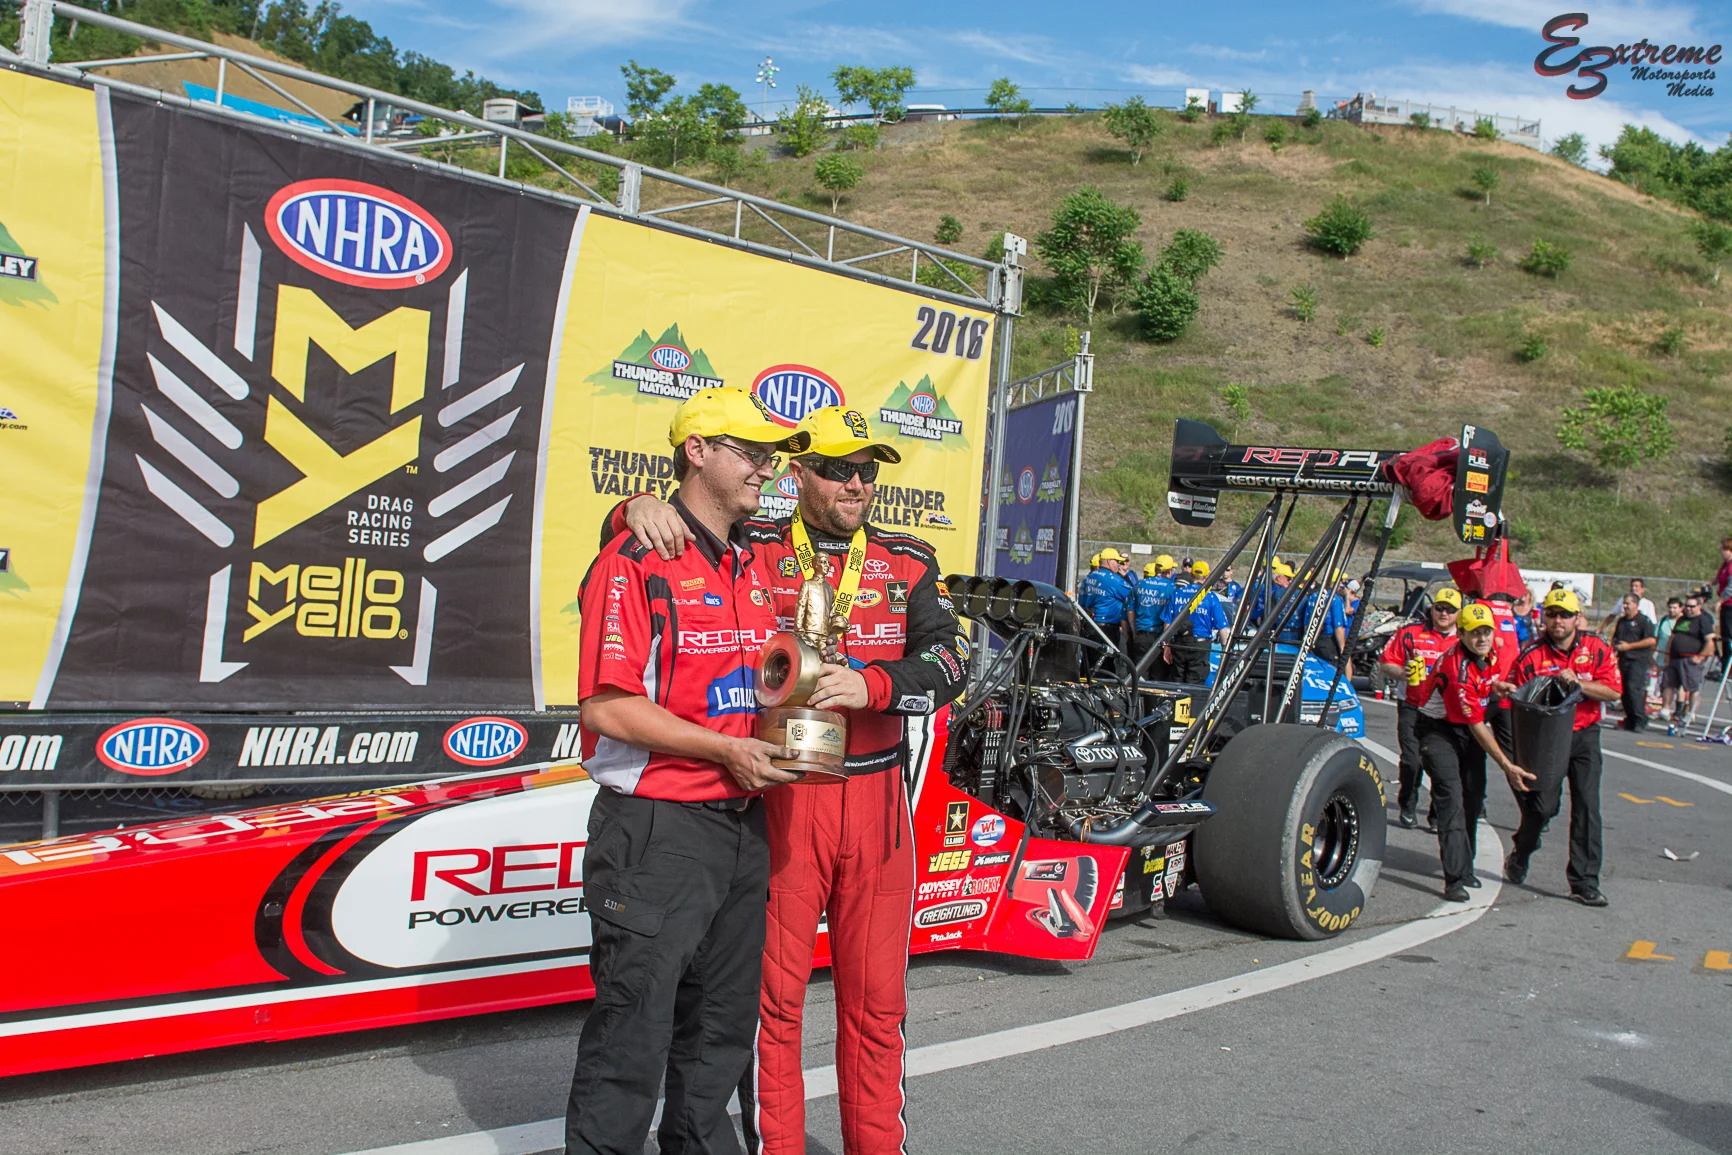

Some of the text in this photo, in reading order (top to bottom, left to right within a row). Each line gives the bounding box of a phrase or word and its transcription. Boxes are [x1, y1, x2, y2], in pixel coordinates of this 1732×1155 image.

[297, 197, 427, 271] NHRA
[911, 306, 989, 360] 2016
[656, 348, 686, 369] NHRA
[614, 362, 674, 386] THUNDER
[766, 375, 832, 419] NHRA
[913, 397, 935, 414] NHRA
[880, 409, 962, 434] THUNDER VALLEY
[900, 424, 942, 440] NATIONALS
[589, 446, 677, 480] THUND
[591, 472, 673, 501] VALLEY
[367, 495, 413, 513] DRAG
[347, 510, 412, 530] RACING
[348, 529, 410, 548] SERIES
[248, 557, 405, 602] Mello
[862, 572, 894, 581] TOYOTA
[854, 592, 878, 602] PENNZOIL
[678, 645, 730, 655] POWERED
[0, 734, 63, 772] om
[114, 727, 193, 765] NHRA
[238, 726, 419, 768] NHRA.com
[456, 725, 516, 761] NHRA
[1094, 746, 1144, 760] TOYTA
[981, 818, 996, 834] wt
[928, 850, 972, 873] JEGS
[983, 854, 1010, 865] IMPACT
[918, 878, 963, 894] ODYSSEY
[971, 876, 1001, 894] ROCKY
[604, 898, 617, 911] 5.11
[918, 890, 960, 902] BATTERY
[921, 903, 981, 924] FREIGHTLINER
